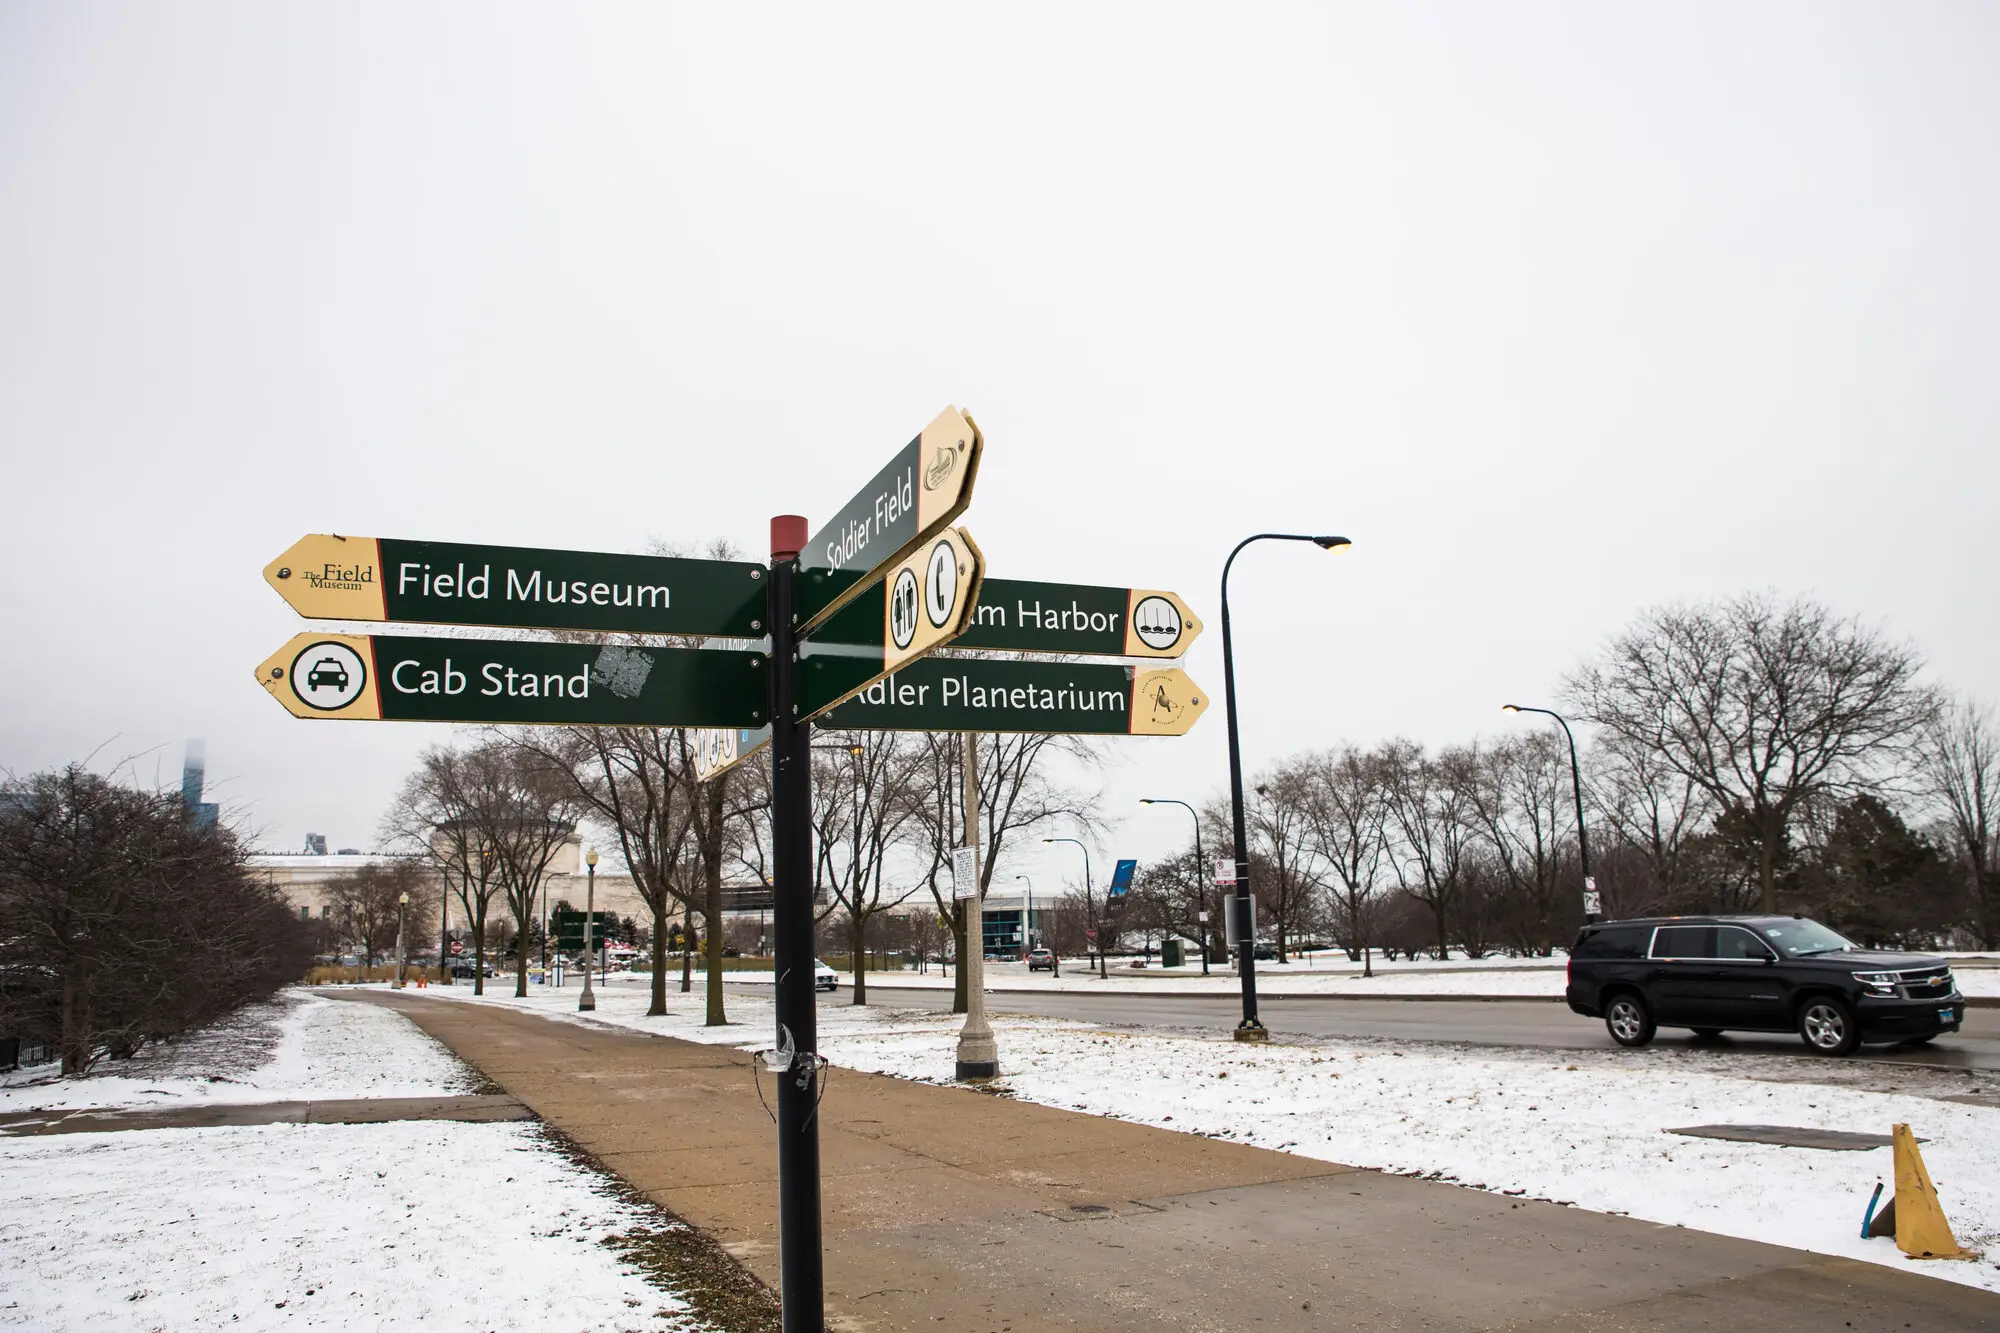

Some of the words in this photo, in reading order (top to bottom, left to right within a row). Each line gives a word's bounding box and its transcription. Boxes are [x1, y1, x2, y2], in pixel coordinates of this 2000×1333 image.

[827, 517, 871, 577] Soldier
[875, 466, 912, 535] Field
[304, 571, 321, 580] The
[324, 564, 373, 583] Field
[310, 579, 362, 590] Museum
[399, 562, 490, 600] Field
[507, 568, 671, 609] Museum
[1018, 600, 1119, 633] Harbor
[391, 658, 467, 696] Cab
[481, 663, 590, 699] Stand
[942, 675, 1125, 711] Planetarium
